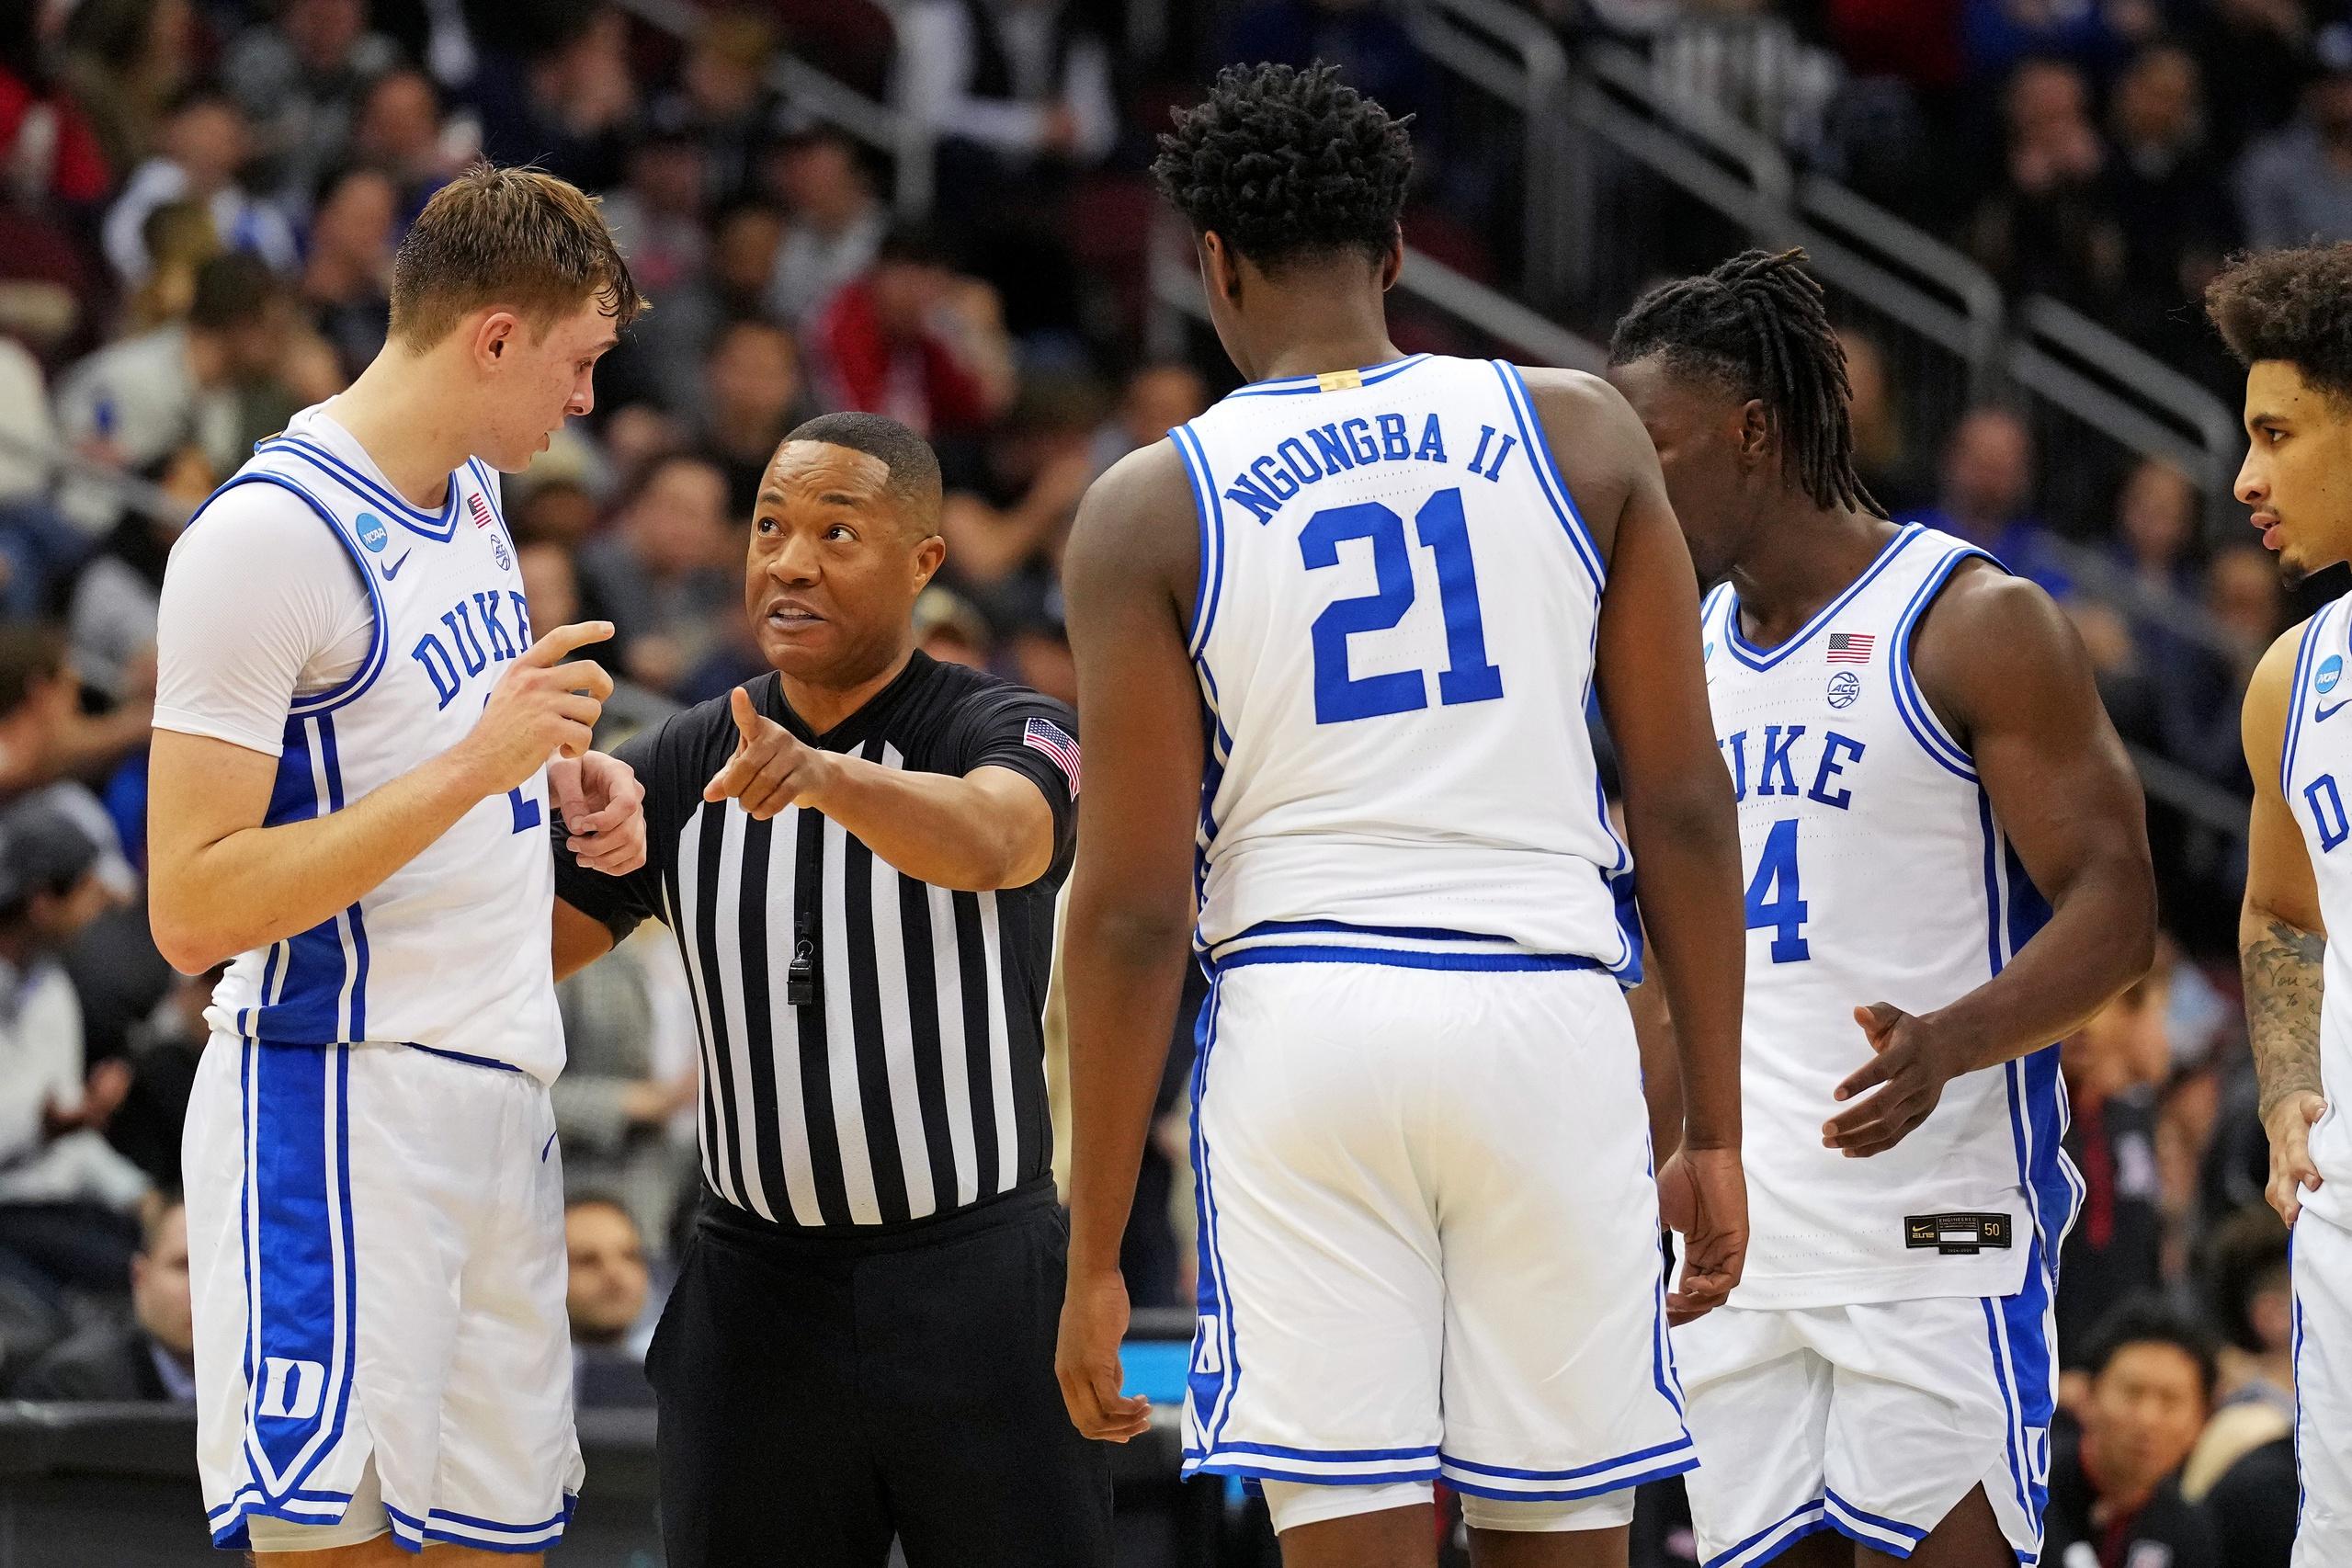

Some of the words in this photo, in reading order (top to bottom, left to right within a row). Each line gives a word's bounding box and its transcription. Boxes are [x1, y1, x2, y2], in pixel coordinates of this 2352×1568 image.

[1223, 413, 1448, 527] NGONGBA
[1467, 425, 1517, 483] II
[362, 528, 387, 544] NCAA
[1298, 487, 1505, 725] 21
[1831, 684, 1859, 693] ACC
[1984, 1223, 2000, 1236] 50
[258, 1357, 325, 1419] D
